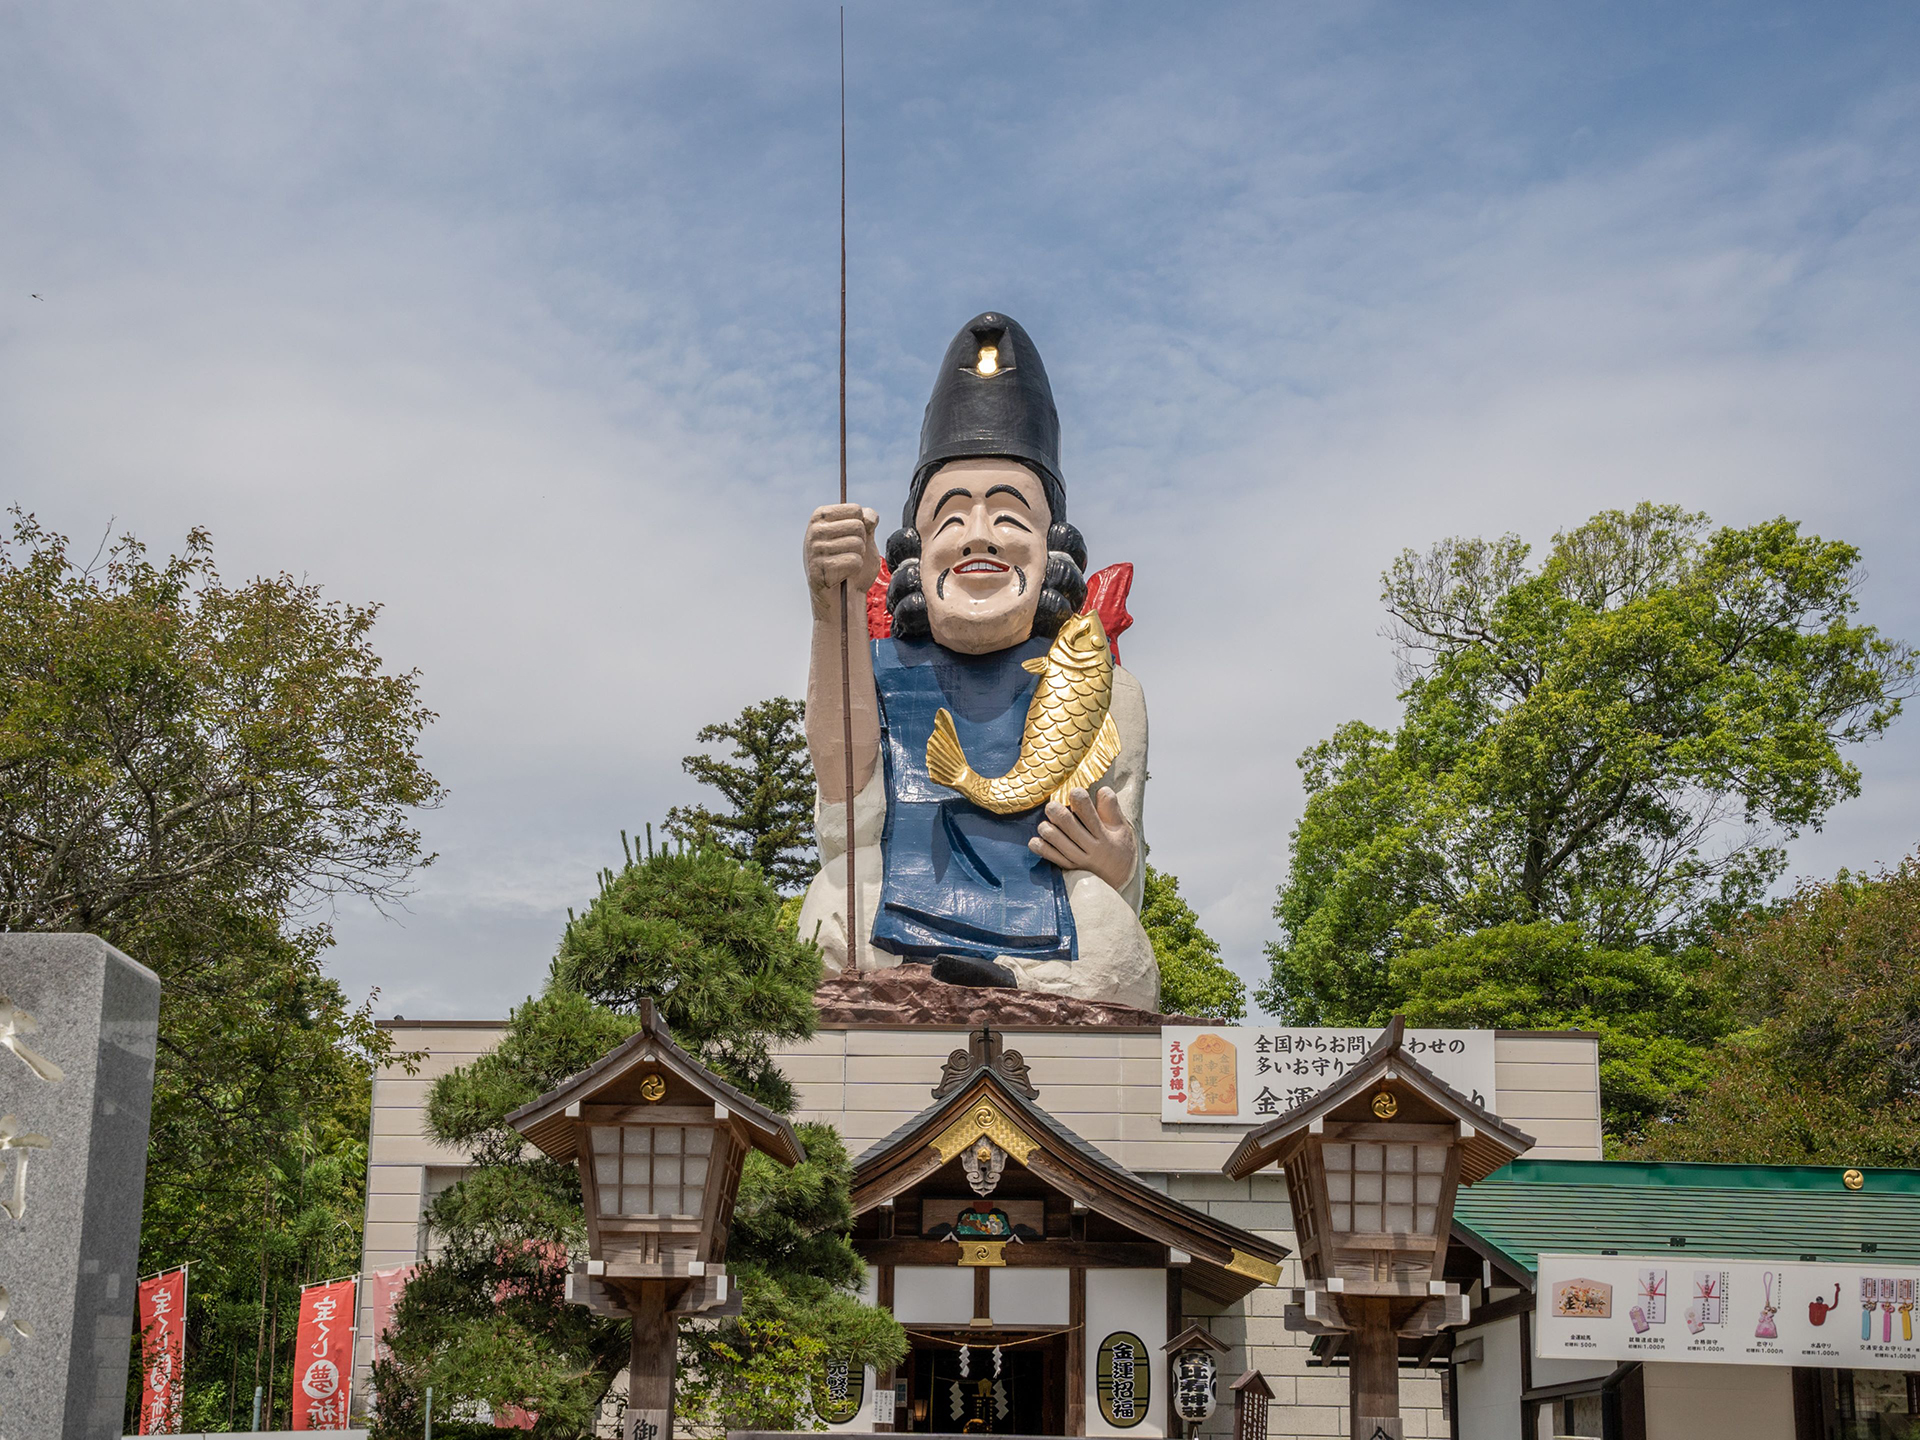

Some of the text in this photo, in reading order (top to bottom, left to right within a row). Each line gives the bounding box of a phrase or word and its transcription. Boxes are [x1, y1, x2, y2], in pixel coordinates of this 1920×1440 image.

[1170, 1041, 1185, 1091] えびす様
[1254, 1034, 1465, 1055] 全国からお問わせの
[1112, 1341, 1134, 1419] 金運招福
